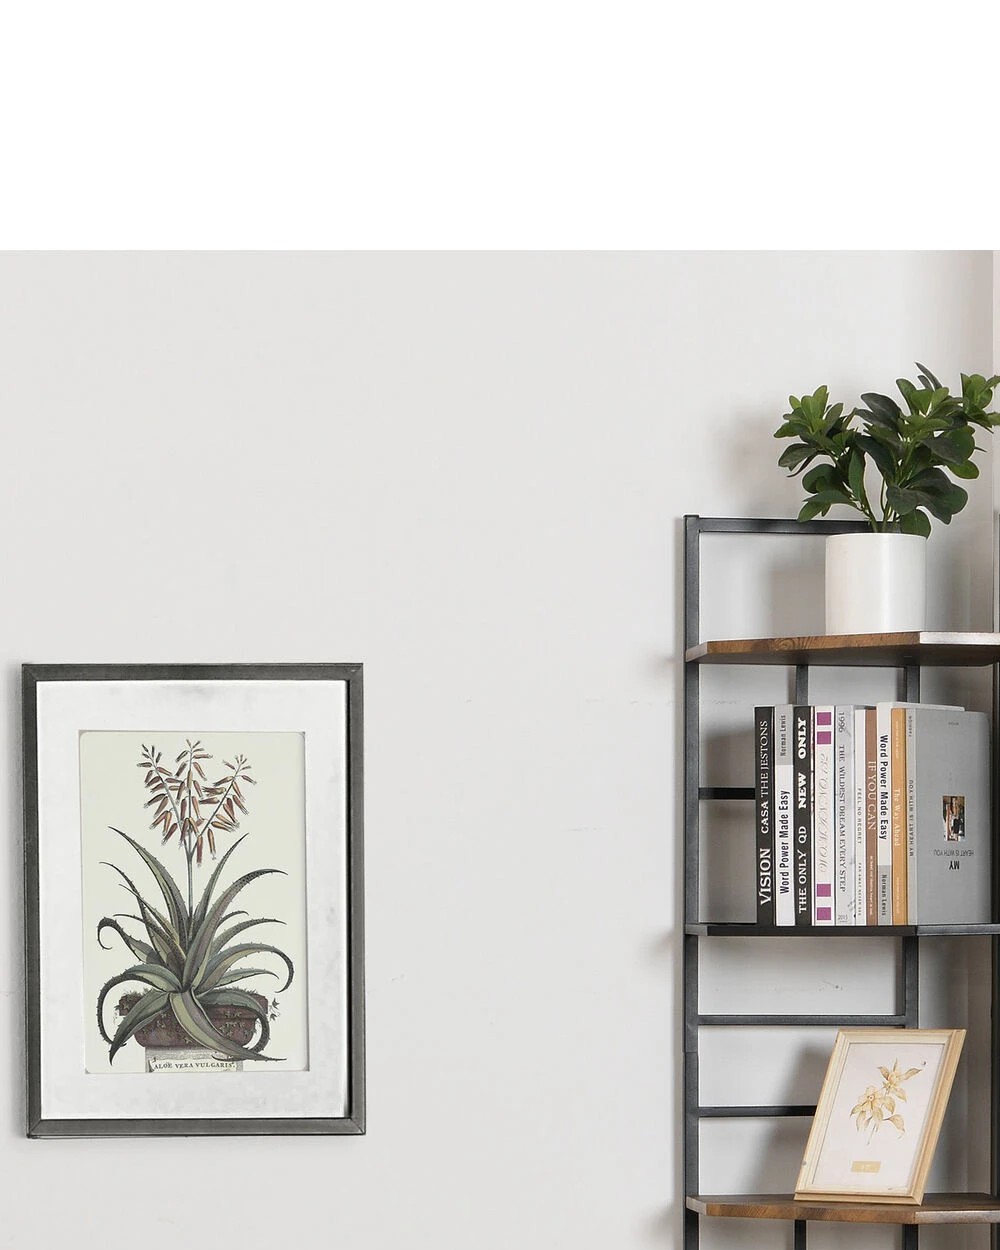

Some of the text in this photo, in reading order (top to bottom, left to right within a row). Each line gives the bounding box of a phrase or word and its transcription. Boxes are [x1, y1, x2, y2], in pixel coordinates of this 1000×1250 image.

[761, 773, 769, 797] THE
[868, 761, 877, 830] IF YOU CAN
[879, 735, 888, 840] Word Power Made Easy
[893, 805, 901, 821] Way
[761, 801, 769, 834] CASA
[779, 790, 790, 894] Word Power Made Easy
[797, 717, 807, 914] THE ONLY QD NEW ONLY
[759, 848, 771, 905] VISION
[949, 860, 960, 870] MY
